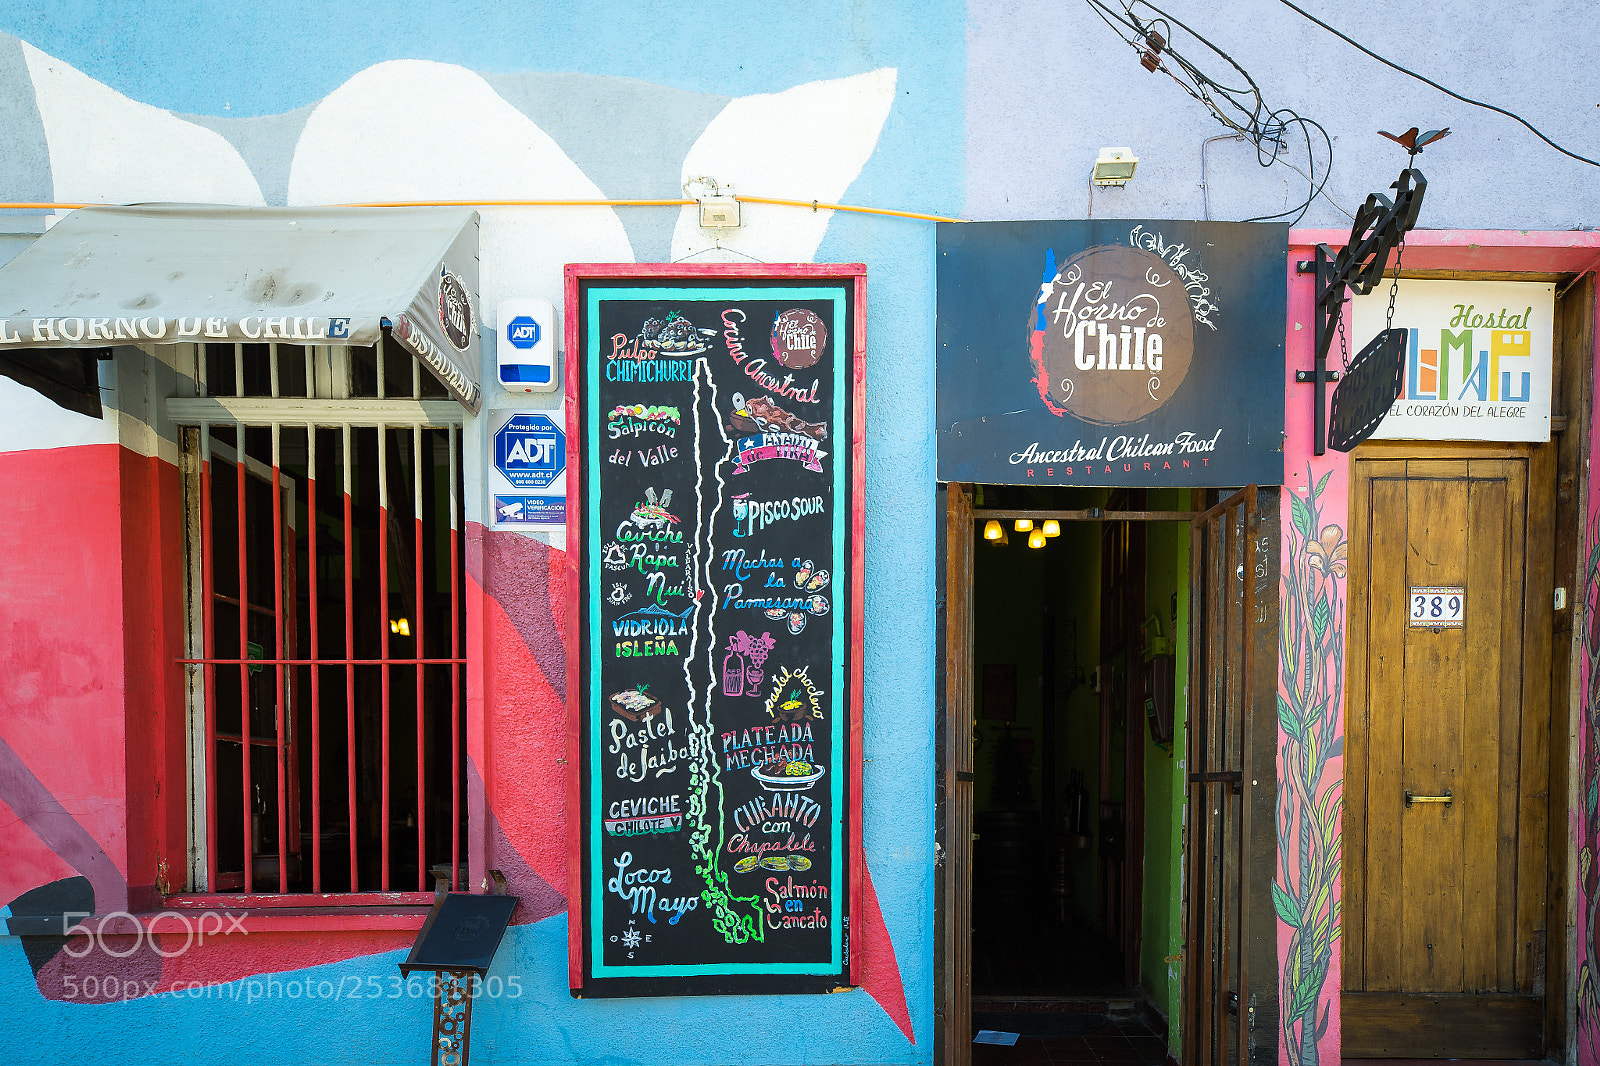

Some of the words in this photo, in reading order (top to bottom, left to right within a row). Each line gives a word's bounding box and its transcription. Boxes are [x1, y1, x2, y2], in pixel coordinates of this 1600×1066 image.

[1085, 281, 1112, 303] El
[1053, 282, 1147, 338] Horno
[1450, 304, 1532, 330] Hostal
[32, 317, 167, 342] HORNO
[178, 317, 229, 338] DE
[238, 317, 352, 340] CHILE
[513, 326, 535, 339] ADT
[786, 333, 817, 350] Chile
[607, 333, 657, 364] Pulpo
[721, 309, 748, 365] Cocina
[745, 358, 820, 403] Ancestral
[1074, 320, 1163, 371] Chile
[398, 313, 481, 408] RESTAURANT
[606, 359, 694, 382] CHIMICHURRI
[1406, 403, 1459, 417] CORAZÓN
[1463, 406, 1483, 418] DEL
[1487, 406, 1526, 418] ALEGRE
[508, 424, 540, 432] Protegido
[608, 418, 676, 440] Salpicón
[506, 438, 556, 463] ADT
[608, 449, 632, 466] del
[638, 445, 678, 467] Valle
[1008, 441, 1103, 465] Ancestral
[1105, 434, 1173, 462] Chilean
[1174, 429, 1223, 454] Food
[509, 471, 552, 479] www.adt.cl
[1027, 458, 1210, 478] RESTAURANT
[748, 500, 790, 536] PISCO
[790, 496, 824, 521] SOUR
[616, 520, 684, 543] Ceviche
[629, 543, 680, 574] Rapa
[721, 548, 785, 581] Machas
[646, 571, 685, 606] Nui
[764, 572, 787, 587] la
[722, 583, 814, 610] Parmesana
[1413, 595, 1461, 618] 389
[612, 618, 688, 637] VIDRIOLA
[615, 636, 679, 658] ISLEÑA
[764, 666, 792, 718] pastel
[608, 707, 676, 754] Pastel
[721, 721, 814, 753] PLATEADA
[726, 743, 815, 772] MECHADA
[609, 794, 680, 819] CEVICHE
[733, 792, 821, 833] CURANTO
[614, 818, 665, 835] CHILOTE
[762, 821, 791, 834] con
[727, 832, 816, 860] Chapalele
[608, 851, 672, 900] Locos
[630, 885, 700, 925] Mayo
[764, 876, 828, 913] Salmón
[785, 899, 803, 912] en
[645, 934, 652, 943] E
[626, 951, 635, 959] S
